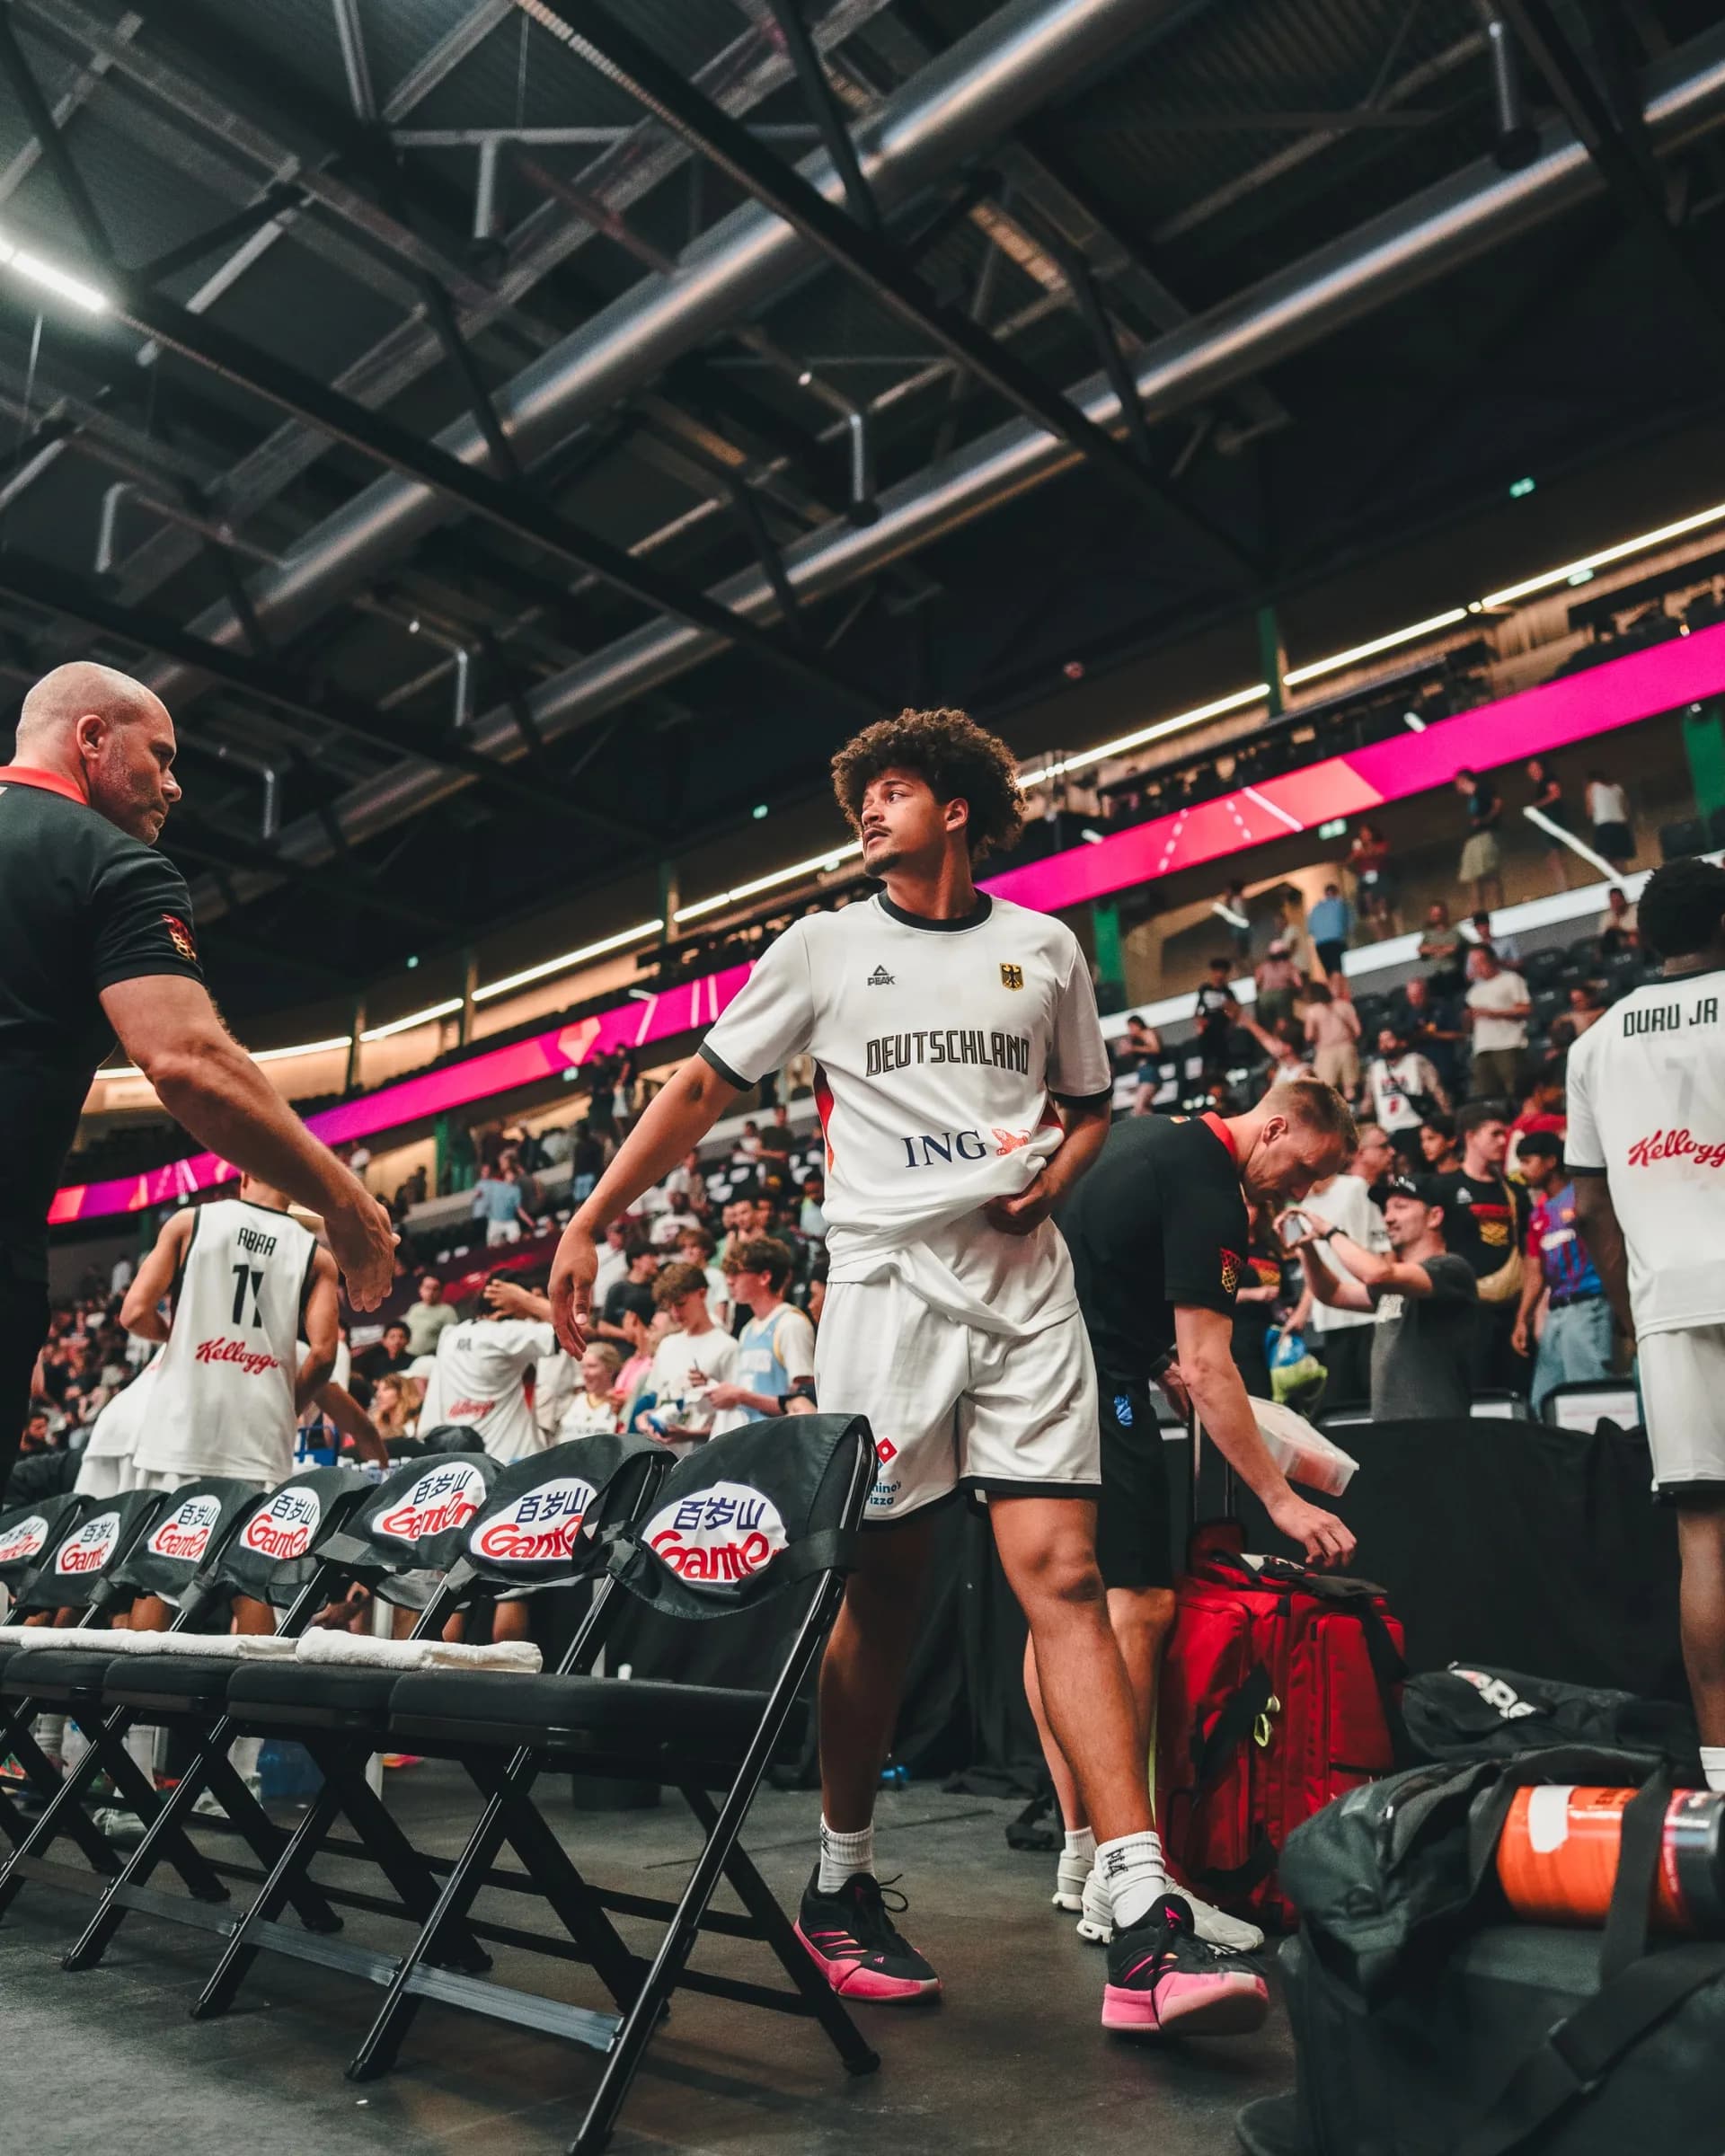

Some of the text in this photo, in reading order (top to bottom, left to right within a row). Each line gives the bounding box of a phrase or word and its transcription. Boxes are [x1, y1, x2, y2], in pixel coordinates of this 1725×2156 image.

[867, 976, 896, 986] PEAK
[1623, 997, 1718, 1038] DURU JR
[866, 1029, 1030, 1077] DEUTSCHLAND
[900, 1129, 988, 1168] ING
[413, 1470, 474, 1505] 百岁山
[516, 1487, 589, 1524] 百岁山
[870, 1494, 895, 1506] izza
[178, 1504, 219, 1526] 百岁山
[270, 1494, 317, 1525] 百岁山
[673, 1497, 766, 1530] 百岁山
[481, 1515, 584, 1558] Gante
[651, 1529, 780, 1580] Gante
